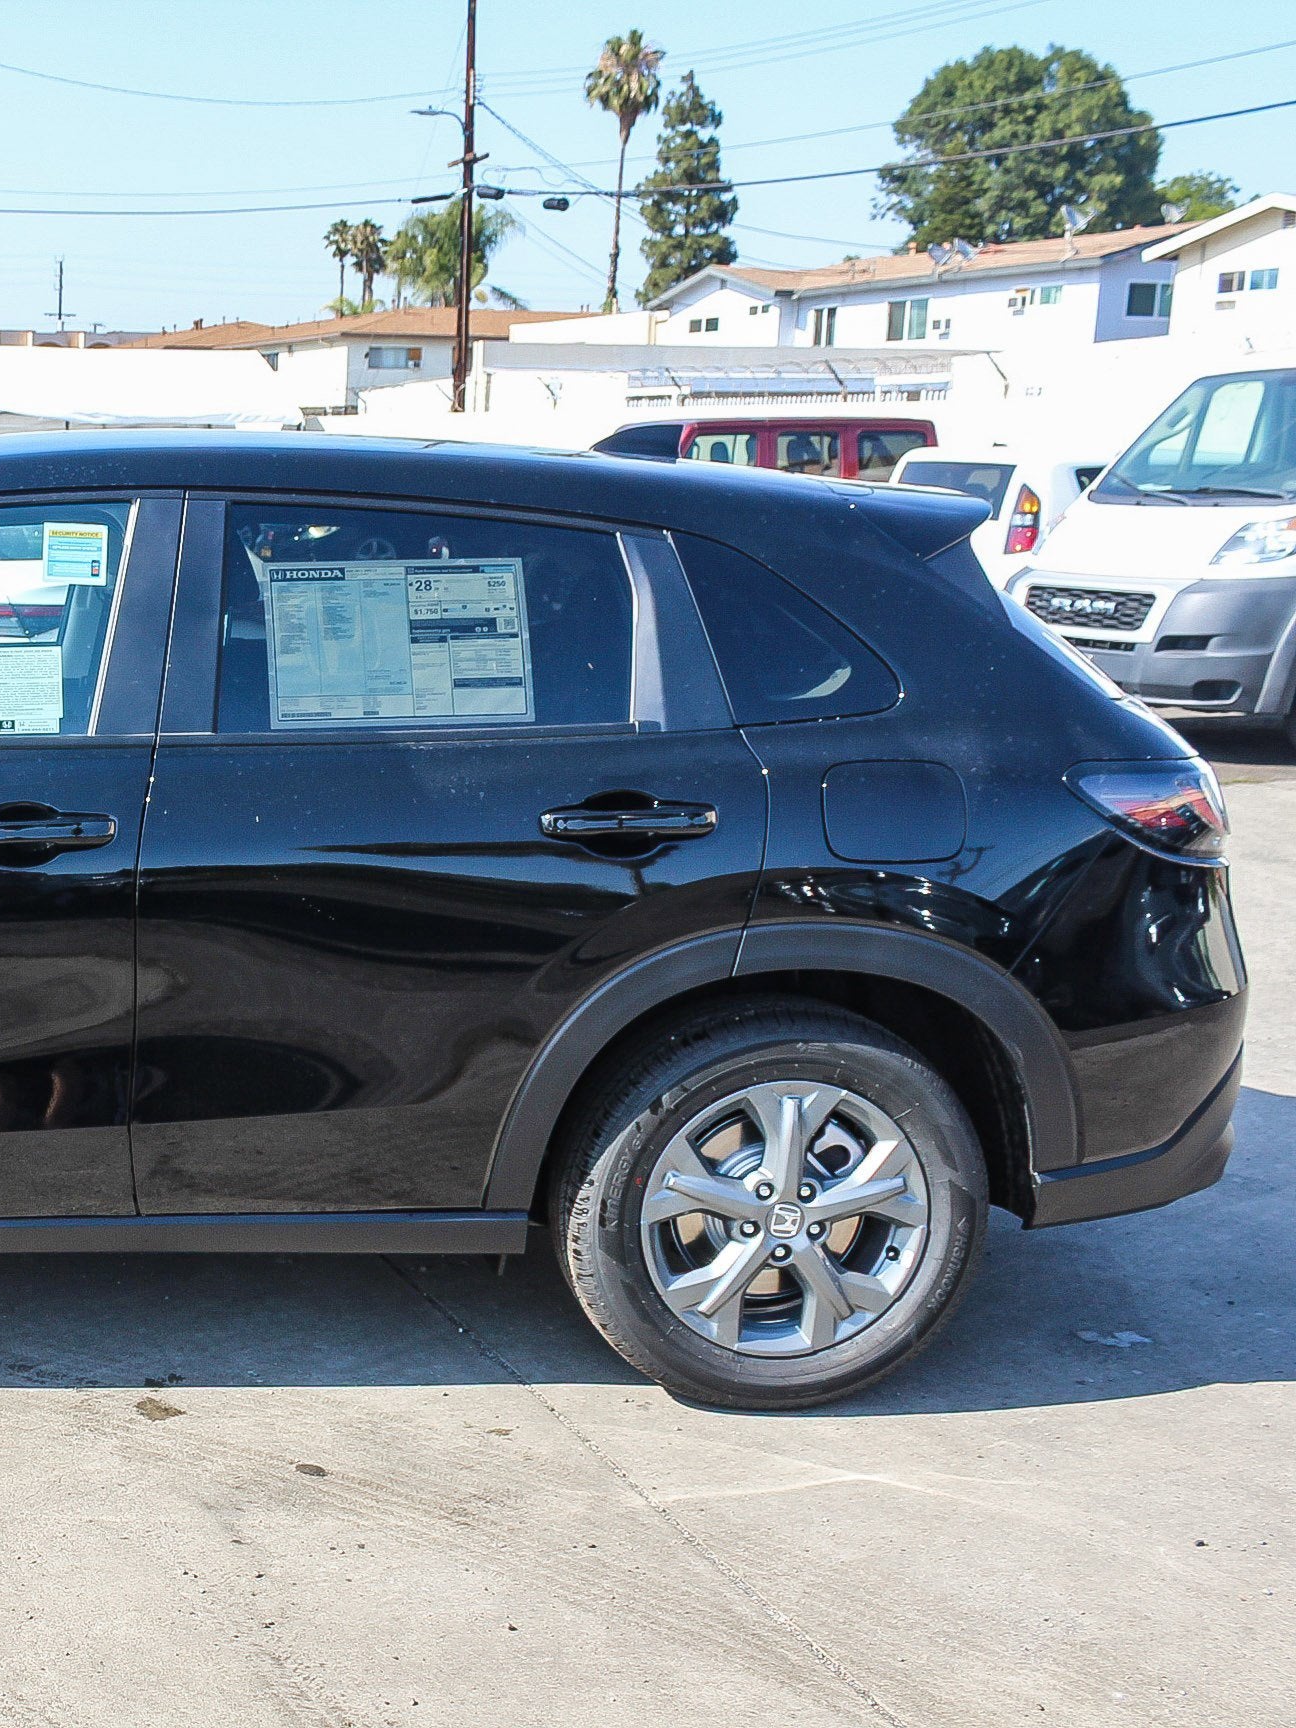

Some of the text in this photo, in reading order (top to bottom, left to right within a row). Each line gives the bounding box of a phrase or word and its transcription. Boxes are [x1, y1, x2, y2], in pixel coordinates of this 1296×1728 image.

[286, 569, 344, 579] HONDA
[414, 579, 433, 592] 28
[487, 580, 506, 588] $250
[1049, 597, 1117, 614] RAM
